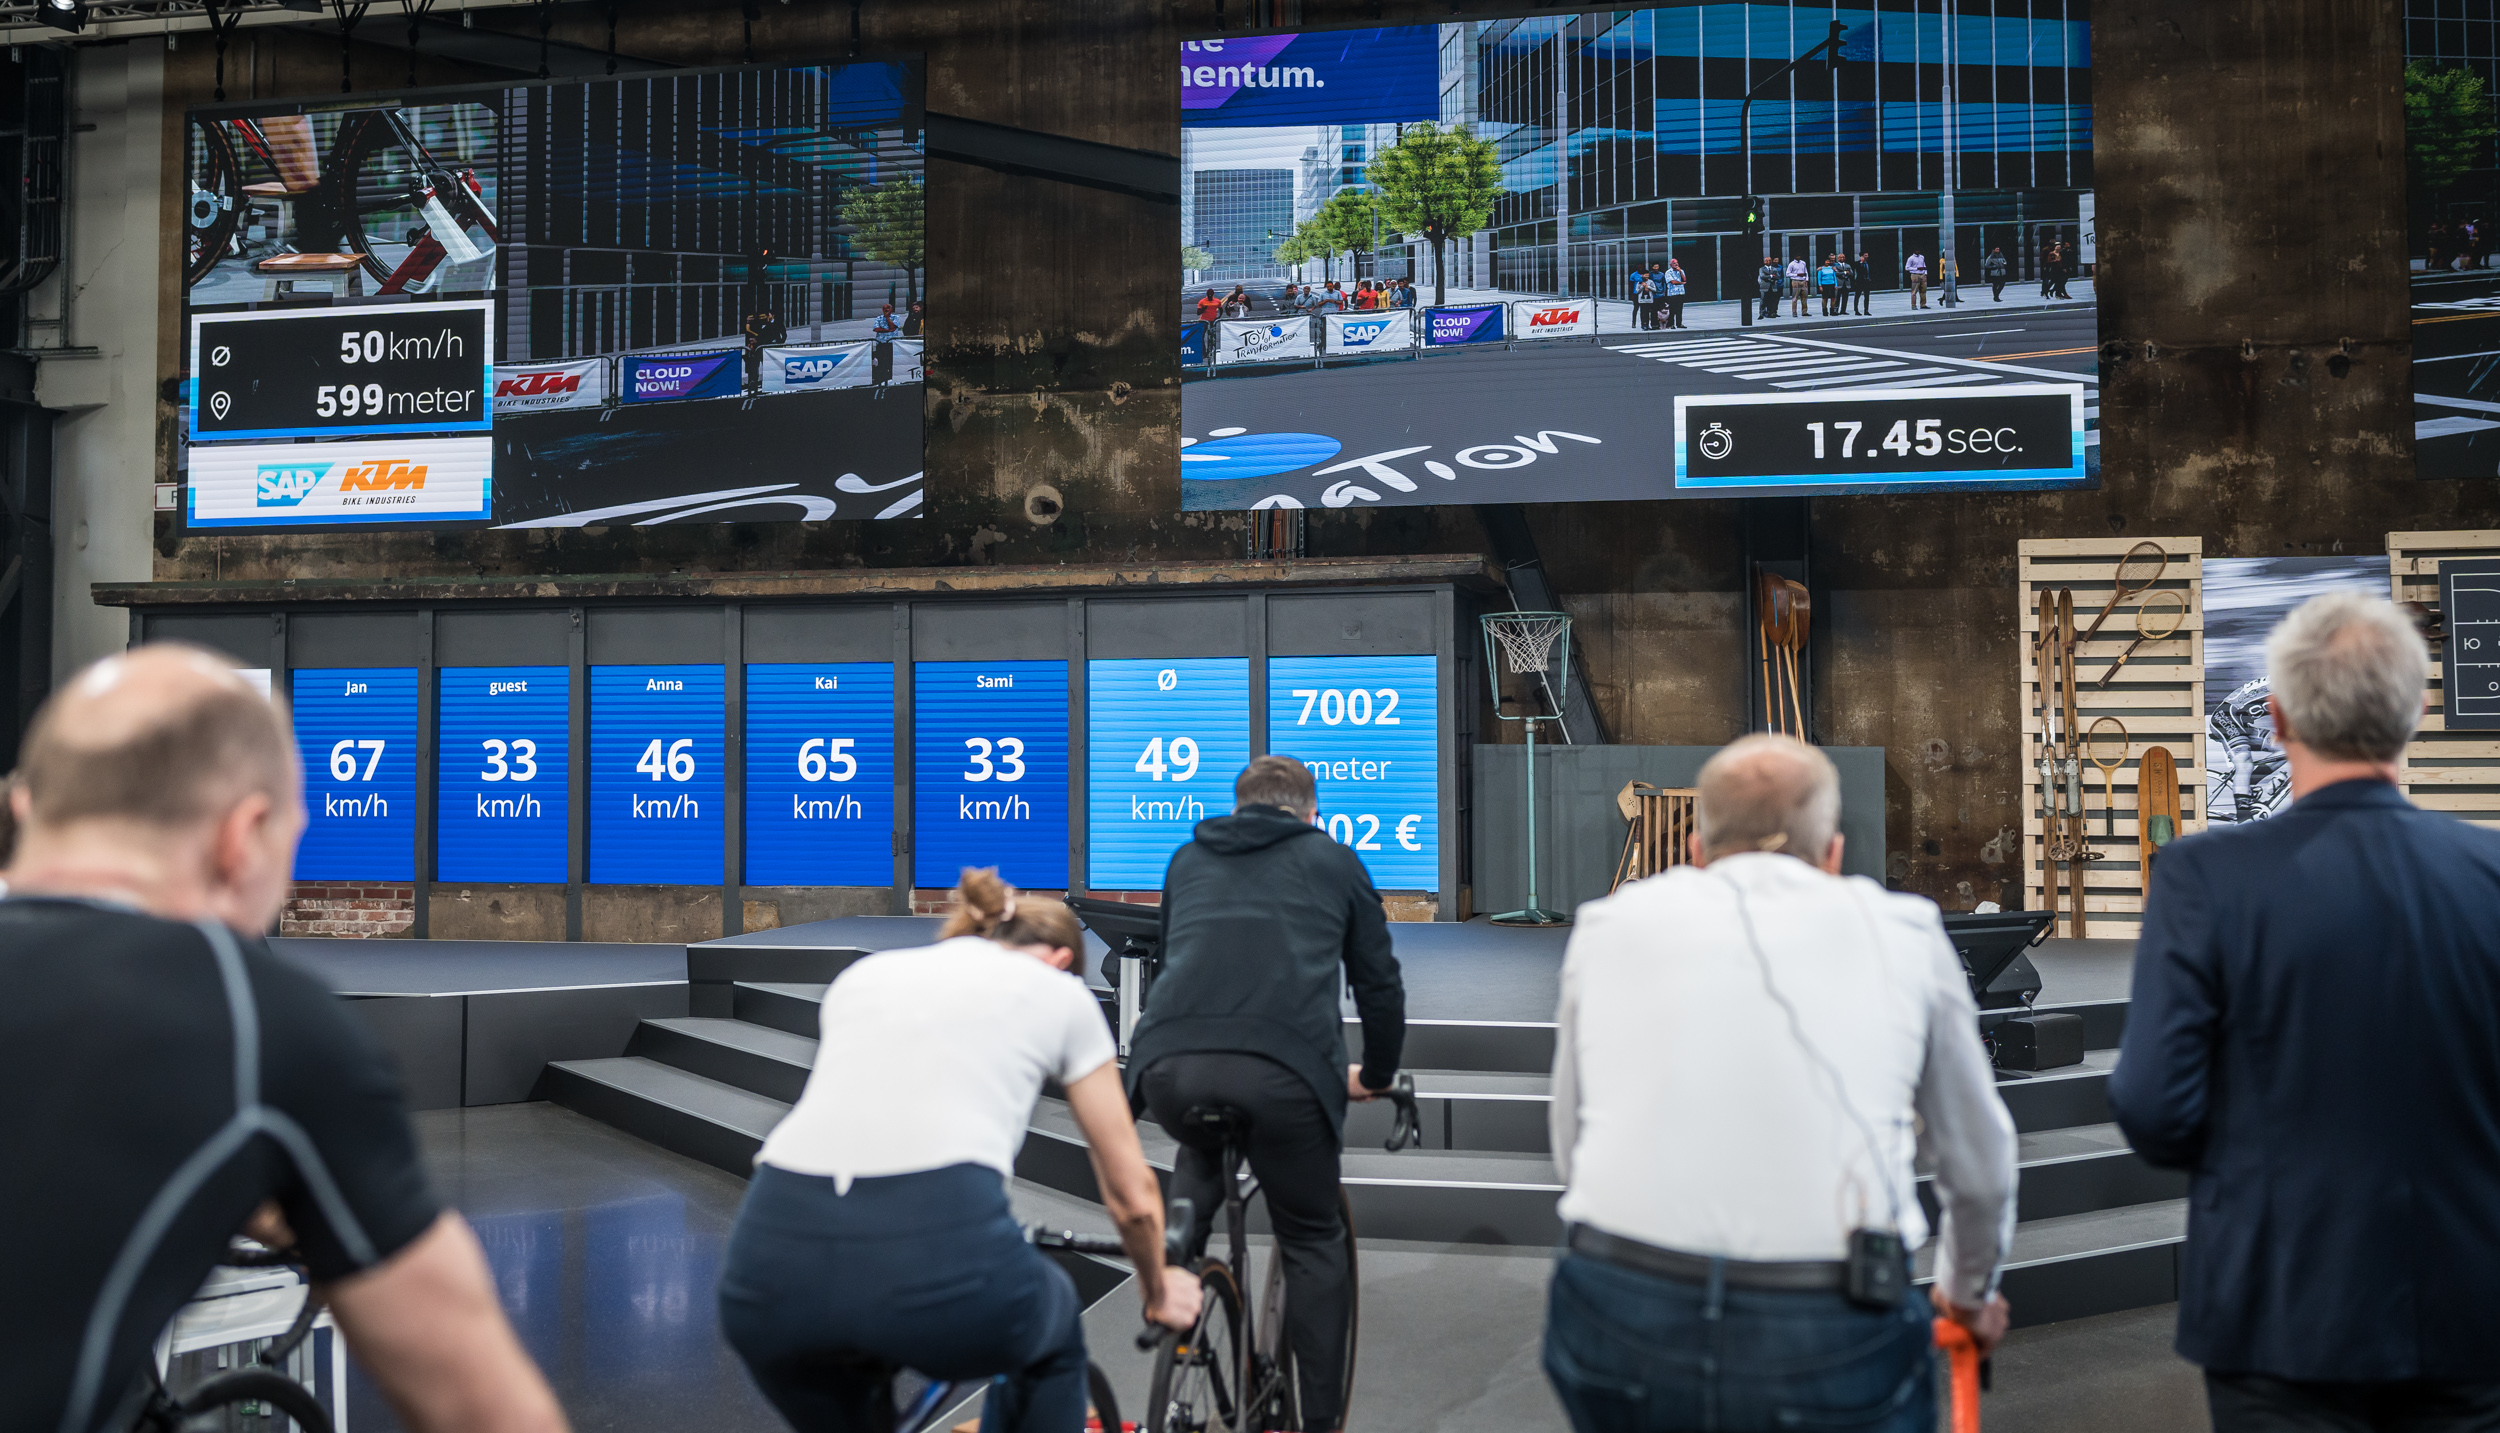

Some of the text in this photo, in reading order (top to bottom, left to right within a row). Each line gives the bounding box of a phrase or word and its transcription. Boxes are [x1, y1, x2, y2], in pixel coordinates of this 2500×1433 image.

[1432, 316, 1471, 328] CLOUD
[1529, 307, 1580, 327] KTM
[1544, 325, 1574, 334] INDUSTRIES
[1343, 325, 1380, 343] SAP
[1432, 327, 1463, 338] NOW!
[635, 366, 692, 380] CLOUD
[785, 359, 834, 380] SAP
[494, 371, 581, 398] KTM
[635, 379, 680, 393] NOW!
[497, 395, 571, 408] BIKE INDUSTRIES
[257, 459, 429, 501] SAP KTM
[342, 495, 417, 506] BIKE INDUSTRIES
[344, 680, 368, 697] Jan
[489, 680, 528, 696] guest
[646, 678, 683, 691] Anna
[815, 676, 838, 690] Kai
[976, 675, 1013, 688] Sami
[1292, 688, 1400, 726] 7002
[330, 739, 385, 782] 67
[481, 738, 537, 782] 33
[636, 738, 695, 782] 46
[798, 738, 857, 782] 65
[964, 737, 1026, 782] 33
[1134, 736, 1200, 782] 49
[326, 793, 388, 818] km/h
[477, 793, 541, 818] km/h
[633, 793, 698, 819] km/h
[794, 793, 861, 819] km/h
[960, 794, 1030, 820] km/h
[1132, 794, 1204, 821] km/h
[1395, 814, 1422, 851] €
